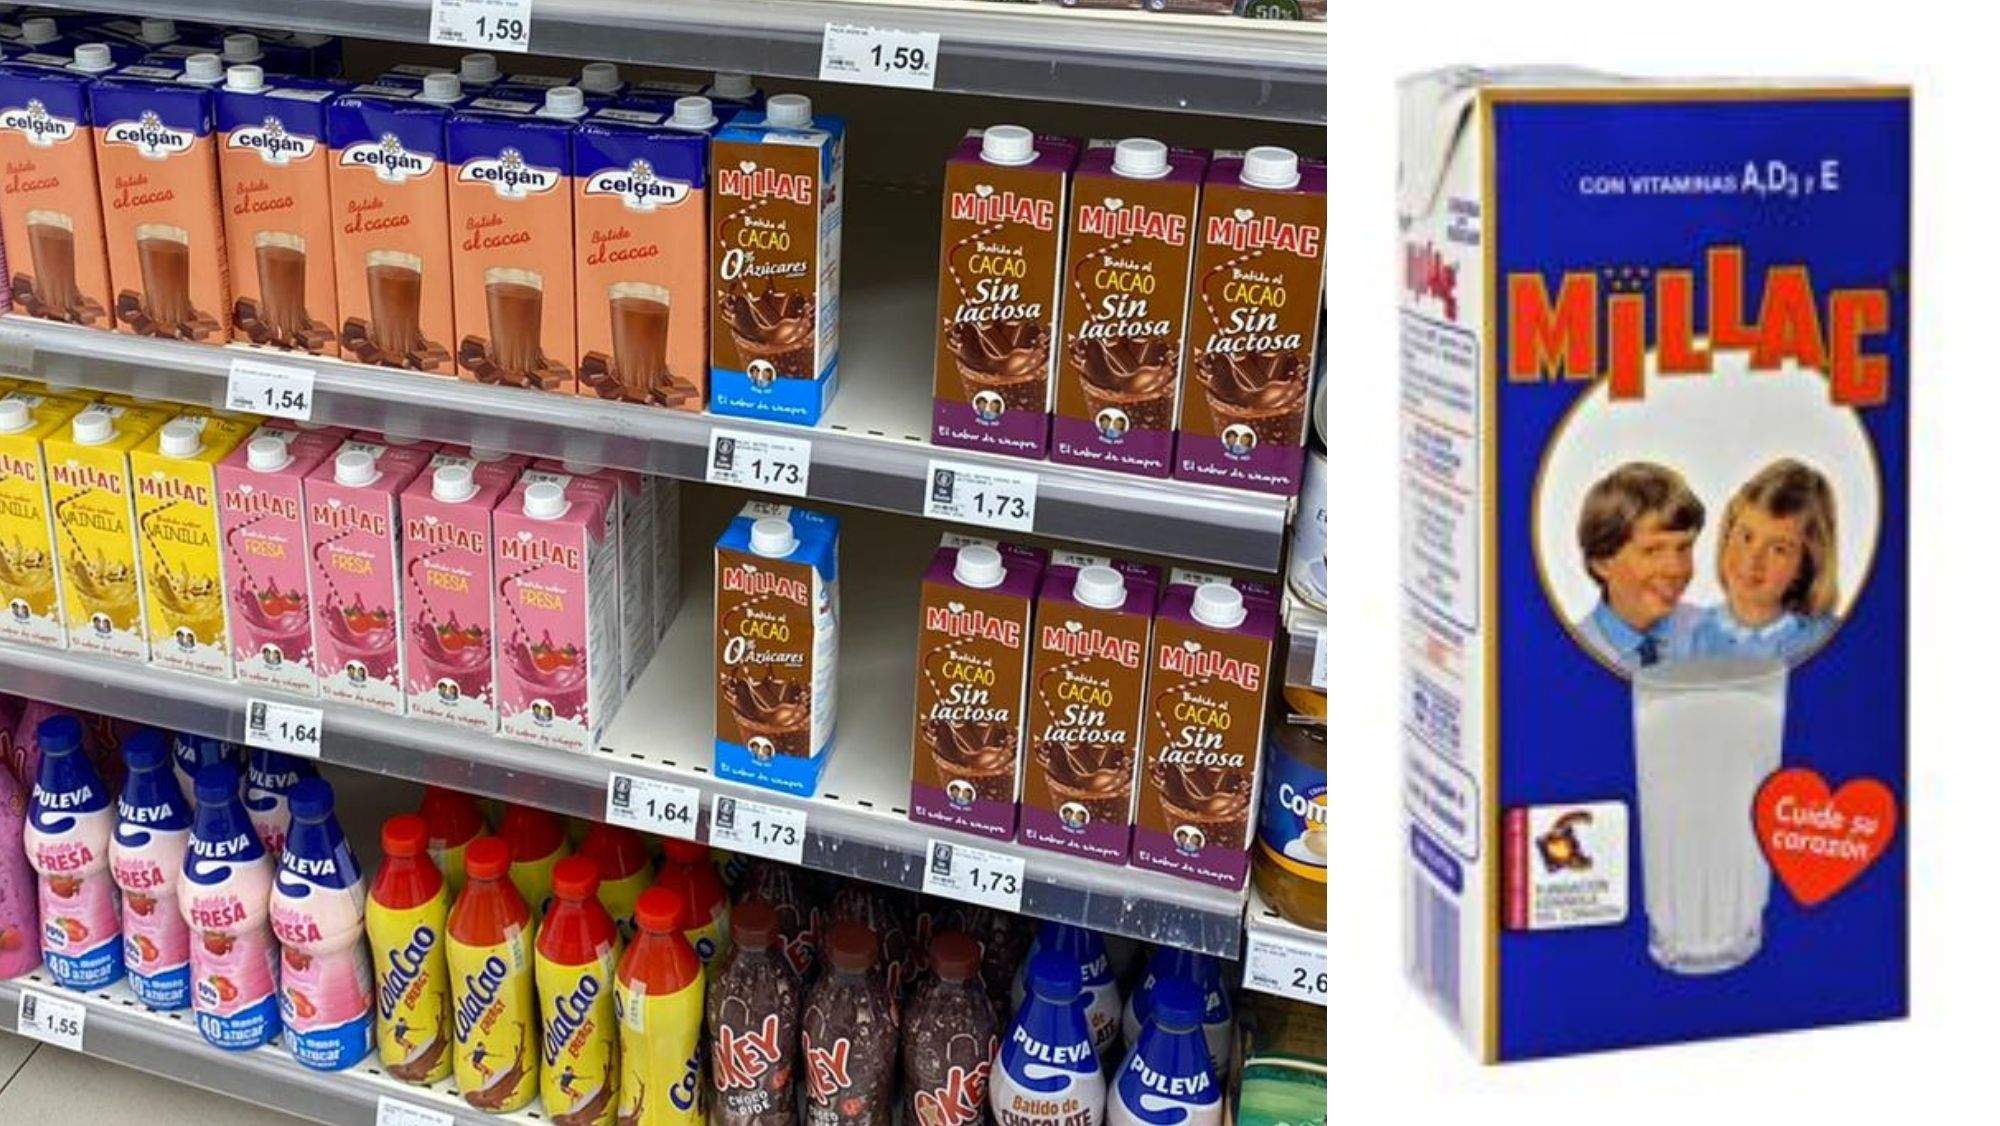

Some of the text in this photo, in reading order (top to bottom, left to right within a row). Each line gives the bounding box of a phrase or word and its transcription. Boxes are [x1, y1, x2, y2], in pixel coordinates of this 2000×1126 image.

[6, 114, 66, 137] celgán
[115, 126, 183, 150] celgán
[238, 131, 305, 154] celgán
[353, 149, 423, 174] celgán
[22, 177, 60, 192] cacao
[471, 164, 545, 189] celgán
[599, 174, 676, 201] celgán
[1579, 175, 1625, 195] CON
[1629, 174, 1738, 195] VITAMINAS
[1820, 159, 1839, 191] E
[133, 190, 175, 206] cacao
[254, 196, 294, 211] cacao
[366, 214, 410, 230] cacao
[483, 231, 530, 247] cacao
[738, 229, 790, 250] CACAO
[609, 245, 659, 263] cacao
[744, 259, 807, 278] Azúcares
[968, 255, 1027, 279] CACAO
[971, 278, 1020, 304] Sin
[1095, 269, 1156, 295] CACAO
[1097, 293, 1148, 321] Sin
[1223, 282, 1286, 308] CACAO
[955, 302, 1042, 324] lactosa
[1224, 307, 1278, 334] Sin
[1079, 317, 1171, 339] lactosa
[1205, 331, 1302, 355] lactosa
[245, 539, 286, 558] FRESA
[332, 554, 373, 575] FRESA
[426, 569, 469, 594] FRESA
[520, 588, 564, 612] FRESA
[740, 619, 790, 643] CACAO
[942, 660, 996, 687] CACAO
[946, 682, 990, 706] Sin
[1058, 682, 1113, 708] CACAO
[930, 703, 1010, 723] lactosa
[1061, 703, 1106, 728] Sin
[1174, 702, 1231, 731] CACAO
[1043, 725, 1127, 745] lactosa
[1177, 725, 1224, 750] Sin
[1159, 746, 1246, 768] lactosa
[1775, 795, 1879, 836] Cuide su
[188, 832, 250, 858] PULEVA
[1771, 829, 1869, 863] corazón
[282, 850, 337, 876] ULEVA
[190, 902, 247, 927] FRESA
[381, 926, 436, 1021] ColaCao
[454, 956, 508, 1045] ColaCao
[544, 974, 601, 1067] ColaCao
[1013, 1024, 1093, 1066] PULEVA
[1131, 1052, 1210, 1097] PULEVA
[1012, 1095, 1080, 1116] Batido de
